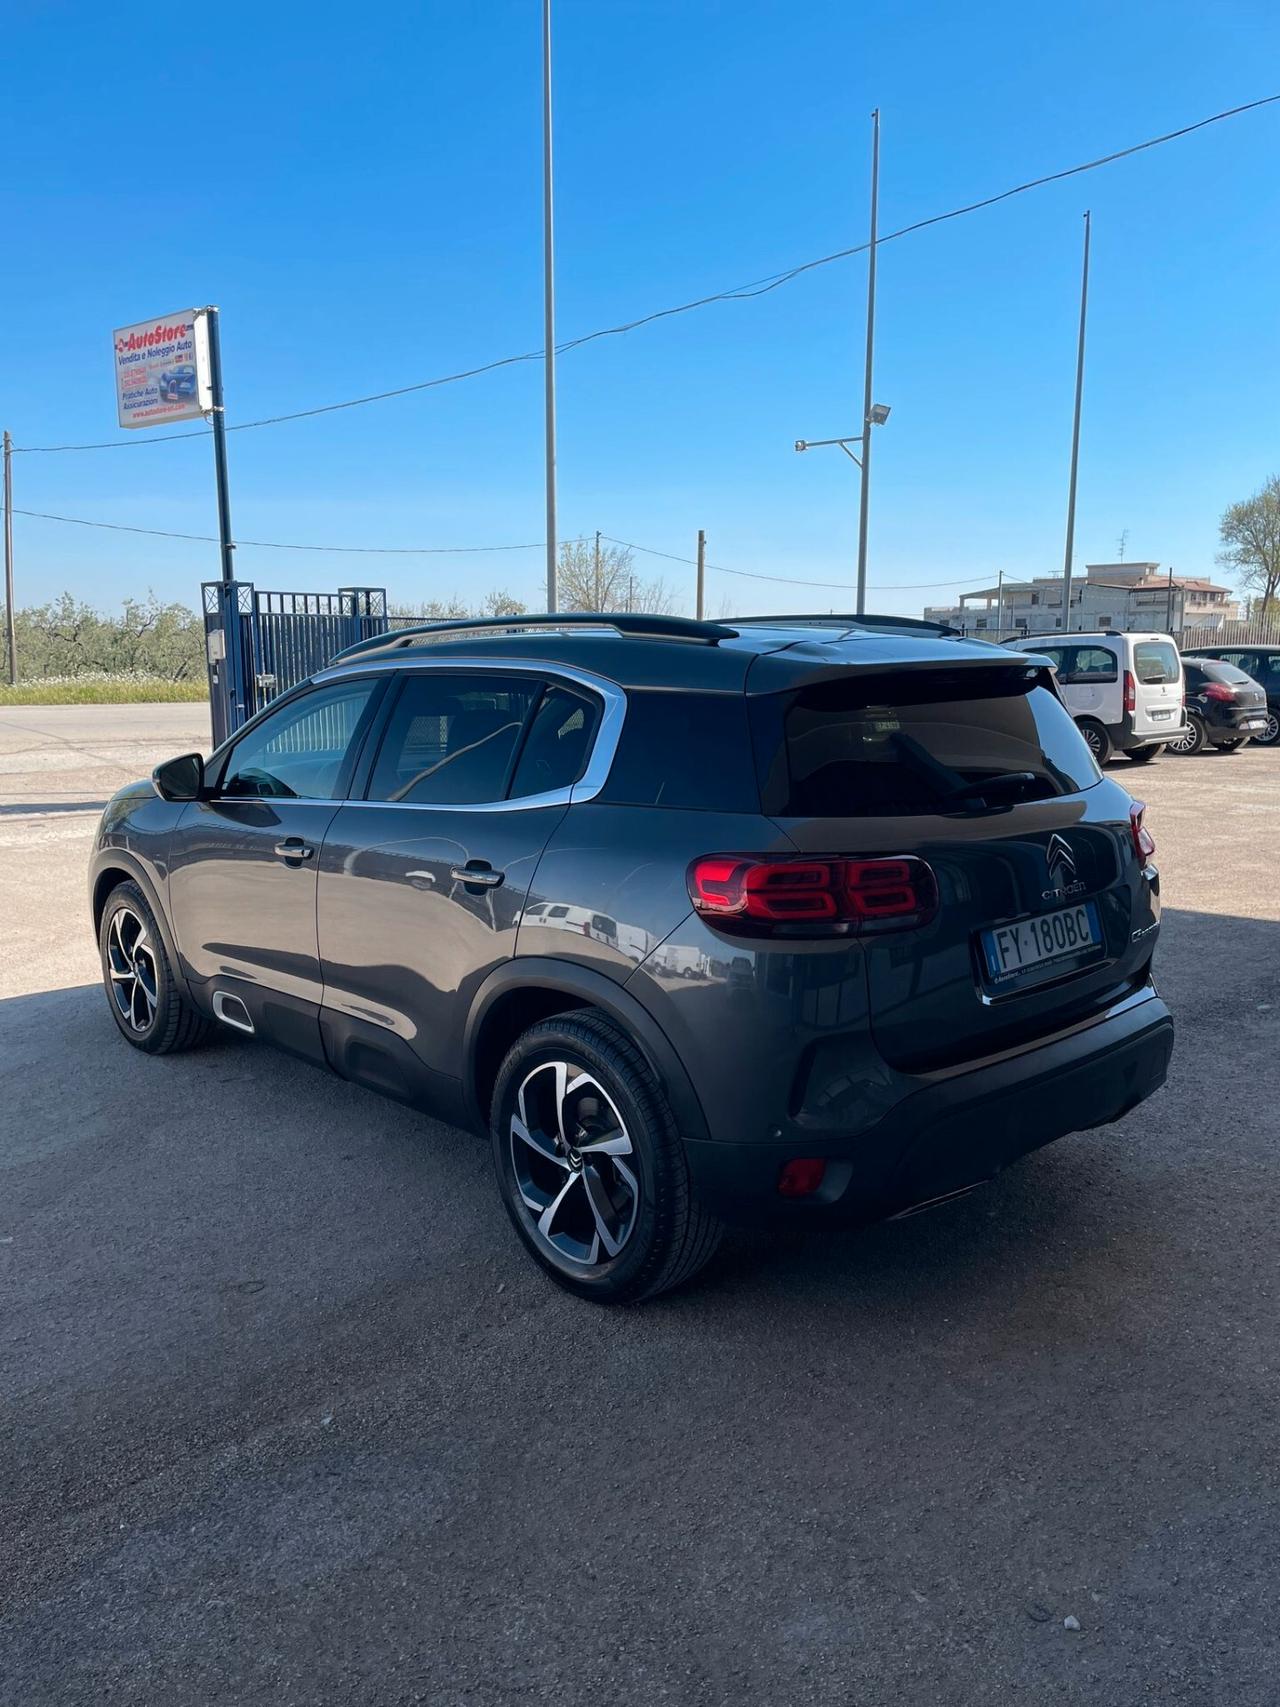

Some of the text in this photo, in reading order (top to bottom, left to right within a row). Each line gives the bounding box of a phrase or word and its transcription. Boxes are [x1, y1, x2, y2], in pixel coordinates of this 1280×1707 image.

[128, 323, 186, 350] AutoStore
[118, 352, 141, 365] Vendita
[147, 345, 176, 358] Noleggio
[176, 340, 193, 352] Auto
[996, 927, 1022, 969] FY
[1030, 909, 1089, 957] 180BC
